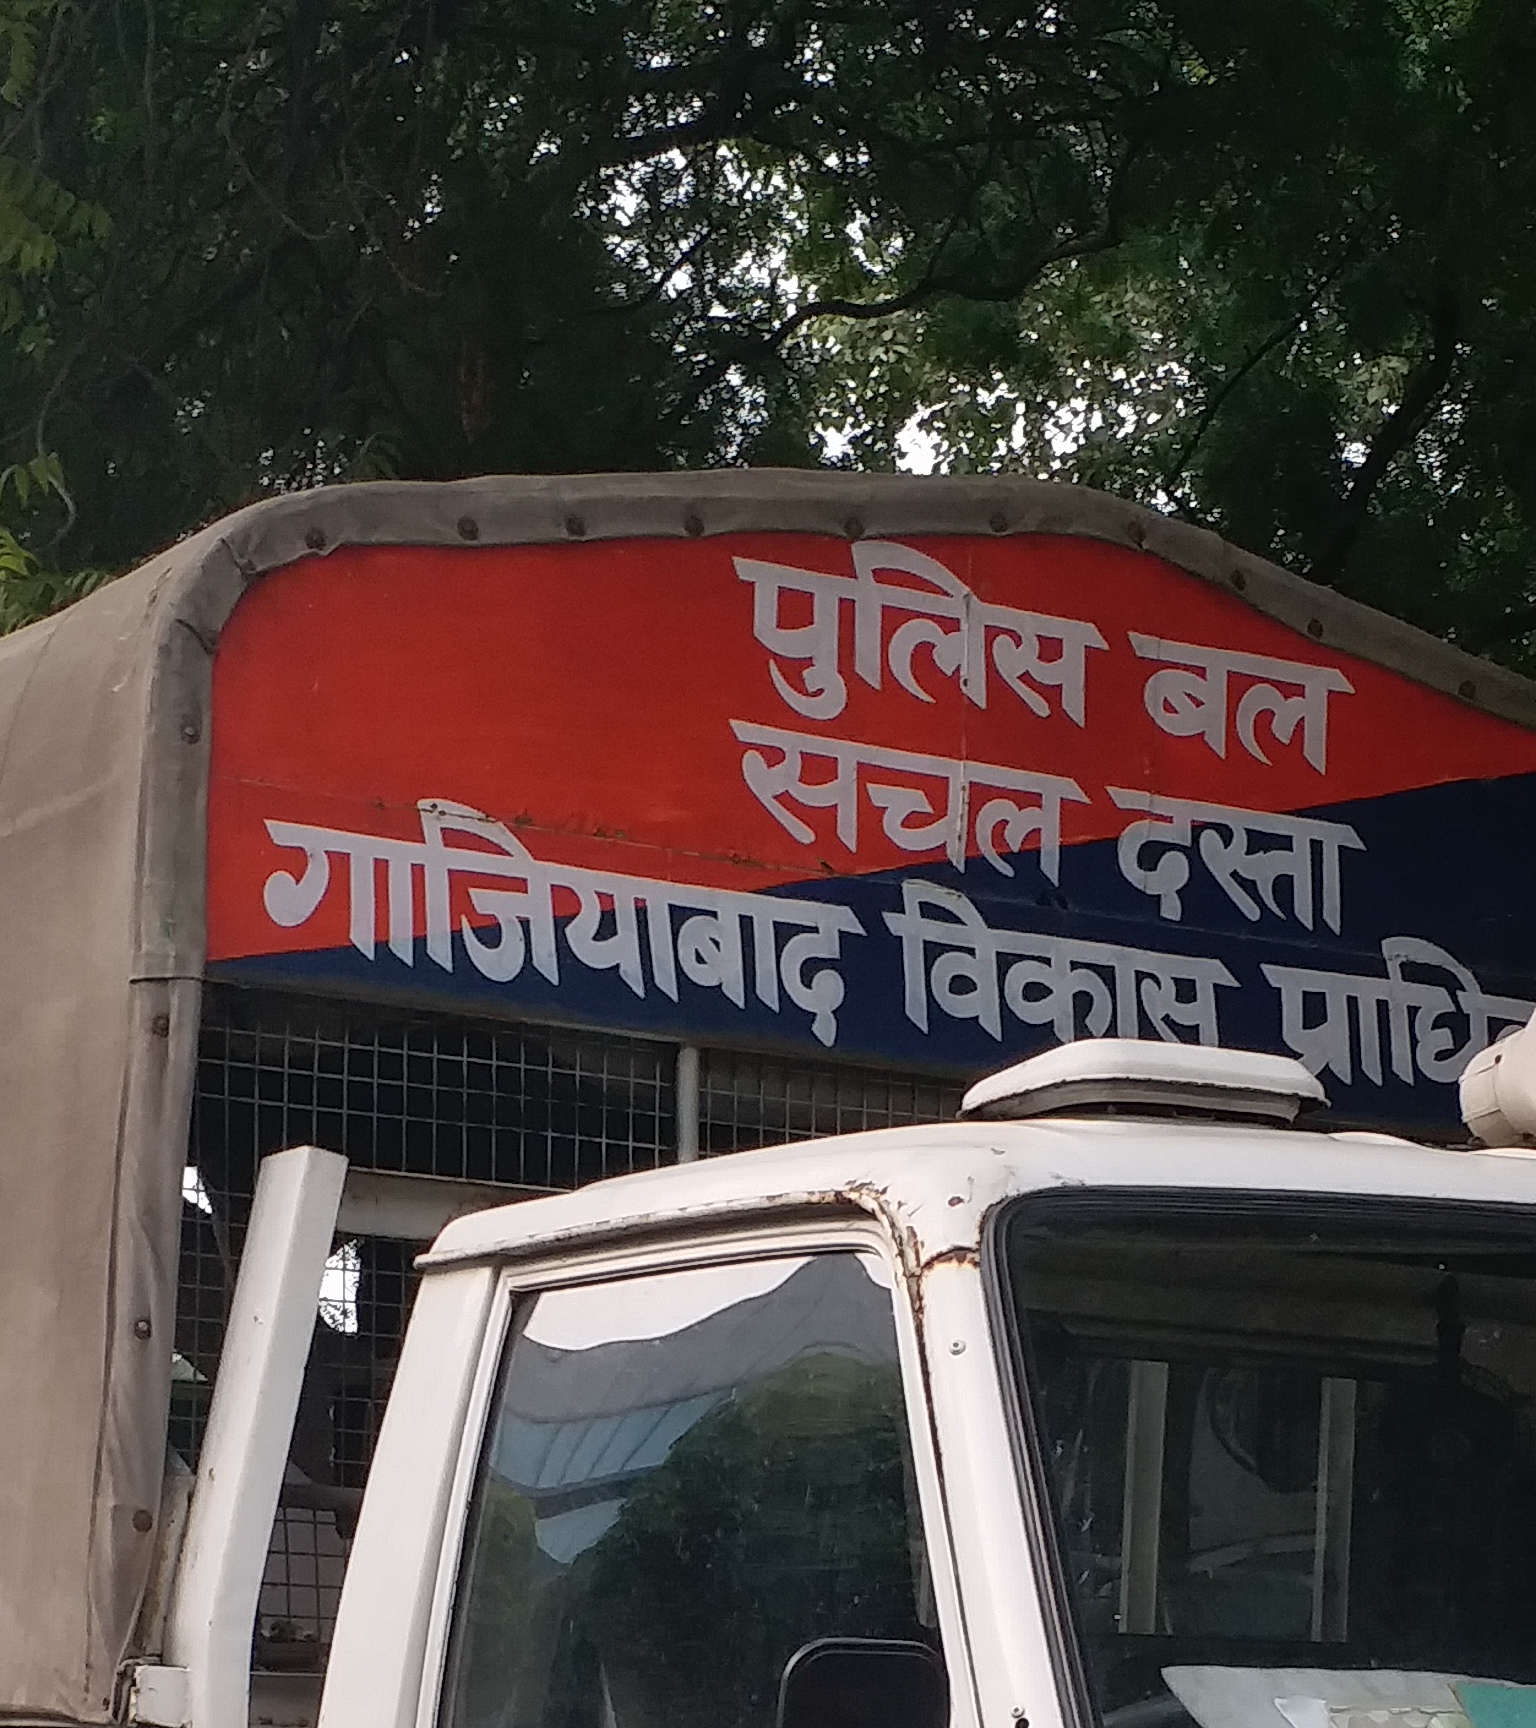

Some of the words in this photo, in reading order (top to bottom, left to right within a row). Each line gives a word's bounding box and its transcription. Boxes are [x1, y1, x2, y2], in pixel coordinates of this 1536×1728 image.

[732, 541, 1109, 728] पुलिस
[1128, 631, 1356, 775] बल
[264, 798, 868, 1048] गाजियाबाद
[882, 878, 1242, 1046] विकास
[729, 719, 1092, 886] सचल
[1105, 786, 1367, 936] दस्ता
